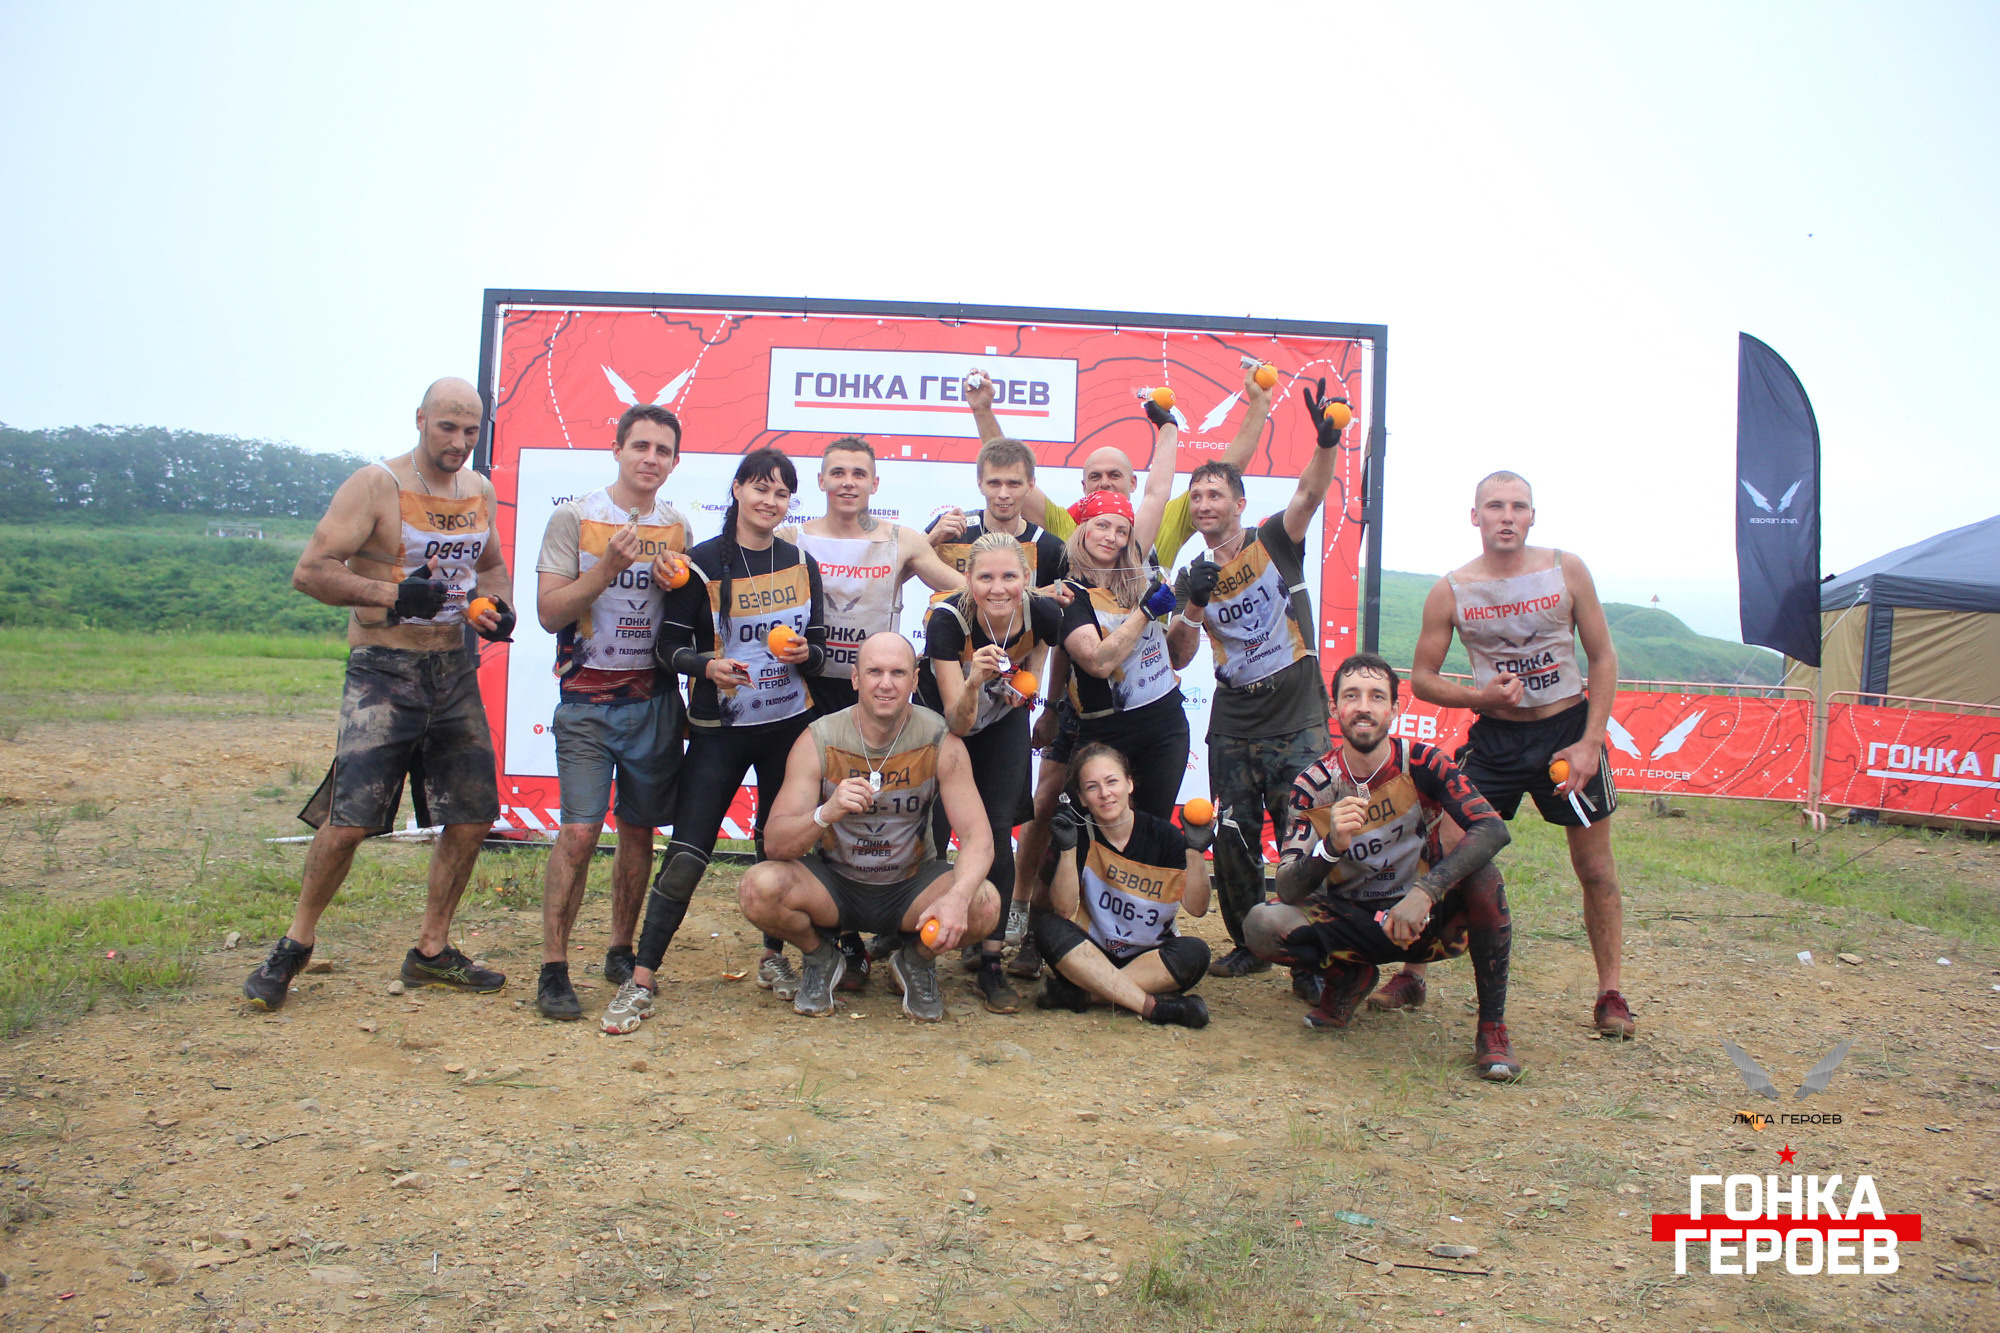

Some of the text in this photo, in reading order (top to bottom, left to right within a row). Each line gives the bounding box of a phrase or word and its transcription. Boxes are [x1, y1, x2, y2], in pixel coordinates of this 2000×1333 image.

[795, 372, 1050, 405] ГОНКА ГЕОЕВ
[869, 509, 899, 517] MAGUCHI
[424, 541, 481, 560] 099-8
[816, 561, 891, 579] СТРУКТОР
[738, 585, 797, 609] ВЗВОД
[1218, 585, 1271, 624] 006-1
[1464, 593, 1561, 620] ИНСТРУКТОР
[619, 617, 651, 626] ГОНКА
[615, 630, 652, 639] ГЕРОЕВ
[823, 625, 866, 642] ОНКА
[826, 648, 858, 664] РОЕ
[1495, 651, 1554, 674] ГОНКА
[760, 666, 790, 677] ГОНКА
[1519, 670, 1560, 691] ОЕВ
[758, 676, 791, 690] ГЕРОЕВ
[1867, 741, 1982, 776] ГОНКА
[1611, 768, 1691, 780] ИГА ГЕРОЕВ
[856, 837, 891, 847] ГОНКА
[852, 848, 892, 857] ГЕРОЕВ
[1107, 864, 1164, 898] ВЗВОД
[1098, 890, 1160, 928] 006-3
